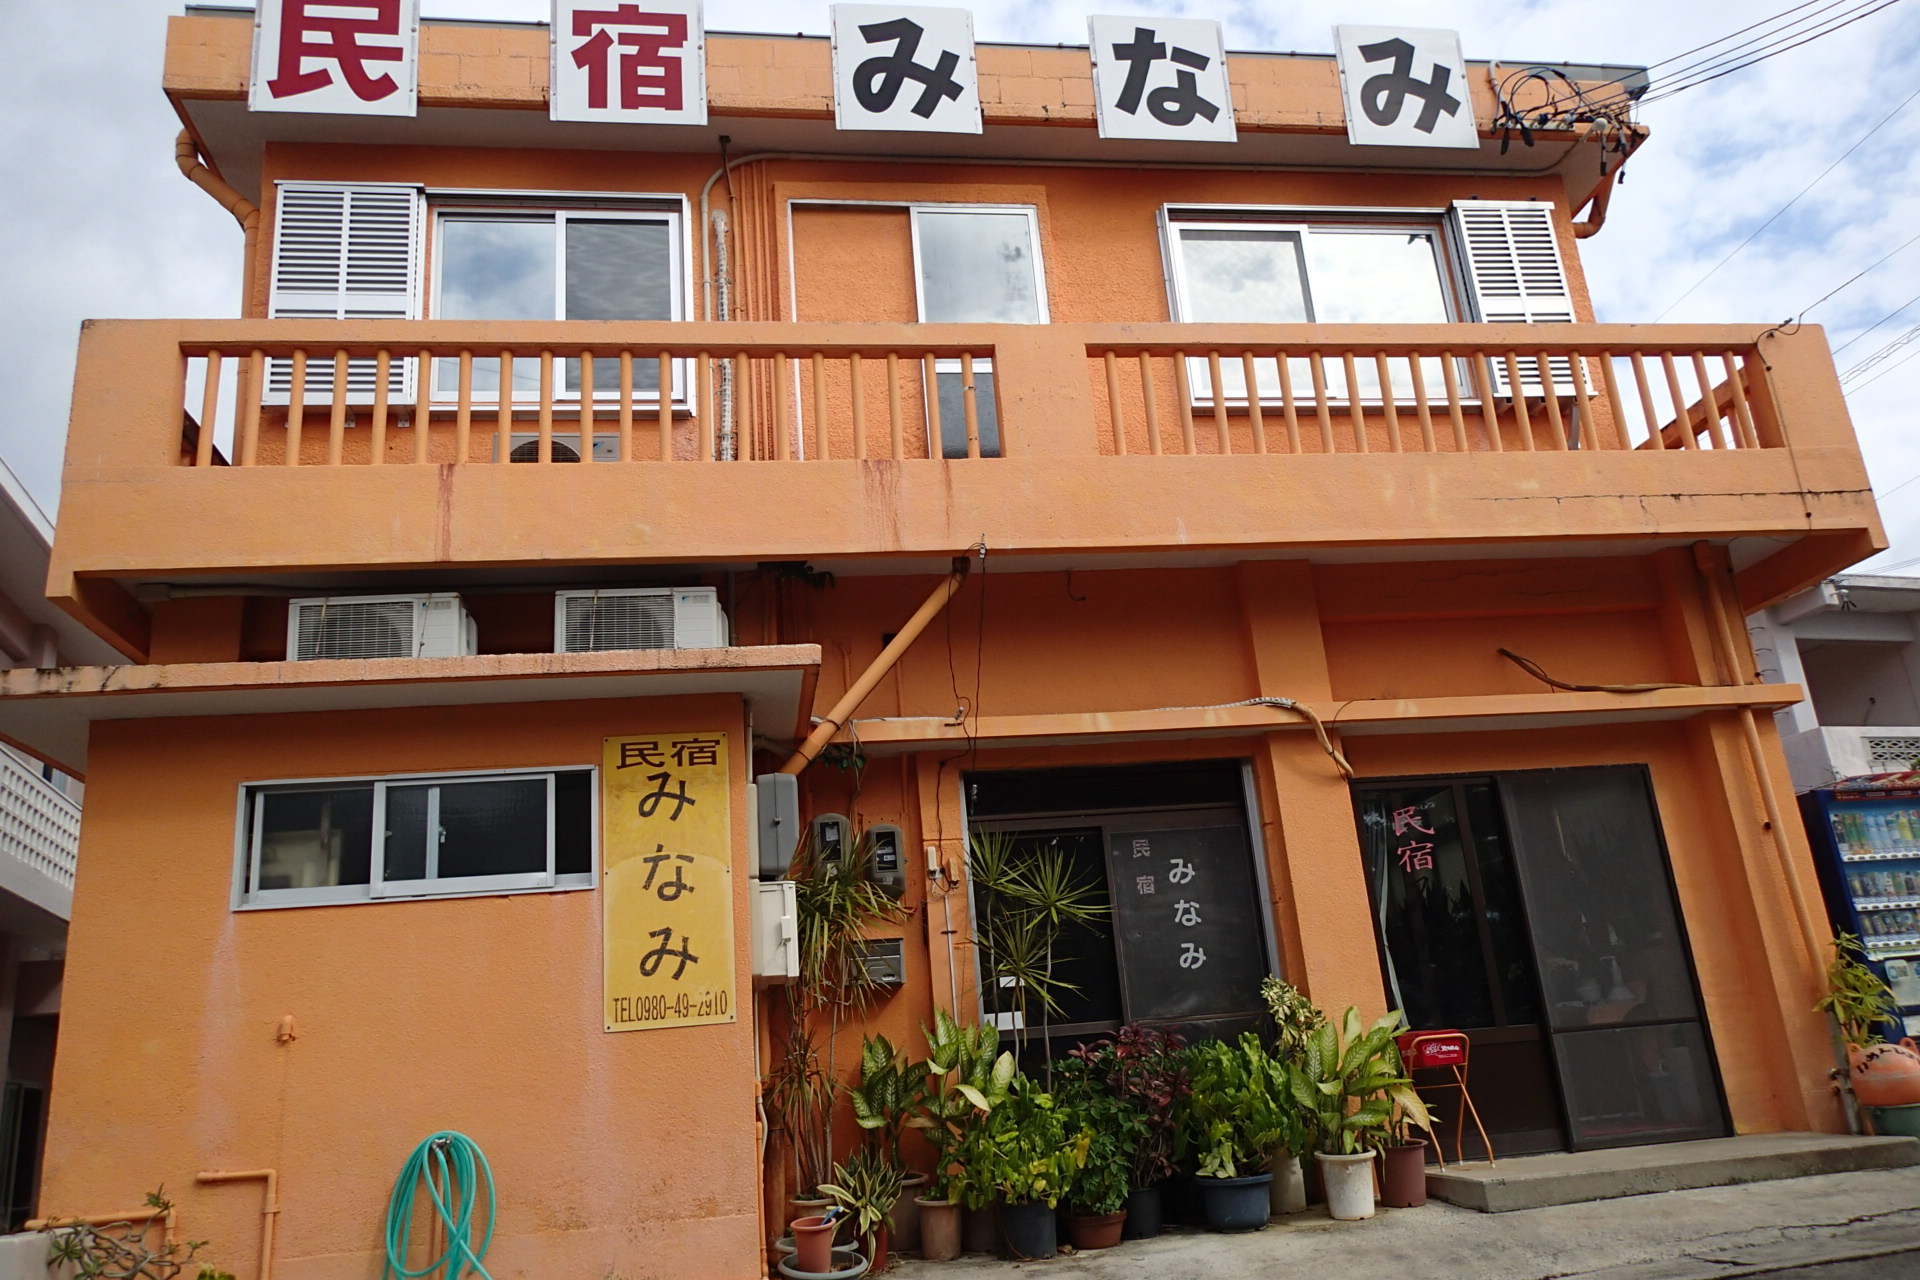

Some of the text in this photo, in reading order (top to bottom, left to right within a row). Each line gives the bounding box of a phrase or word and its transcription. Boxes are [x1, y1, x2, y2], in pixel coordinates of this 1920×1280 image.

[616, 738, 721, 769] 民宿
[1132, 839, 1155, 895] 民宿
[1392, 805, 1435, 873] 民宿
[638, 771, 699, 981] みなみ
[1168, 858, 1207, 970] みなみ
